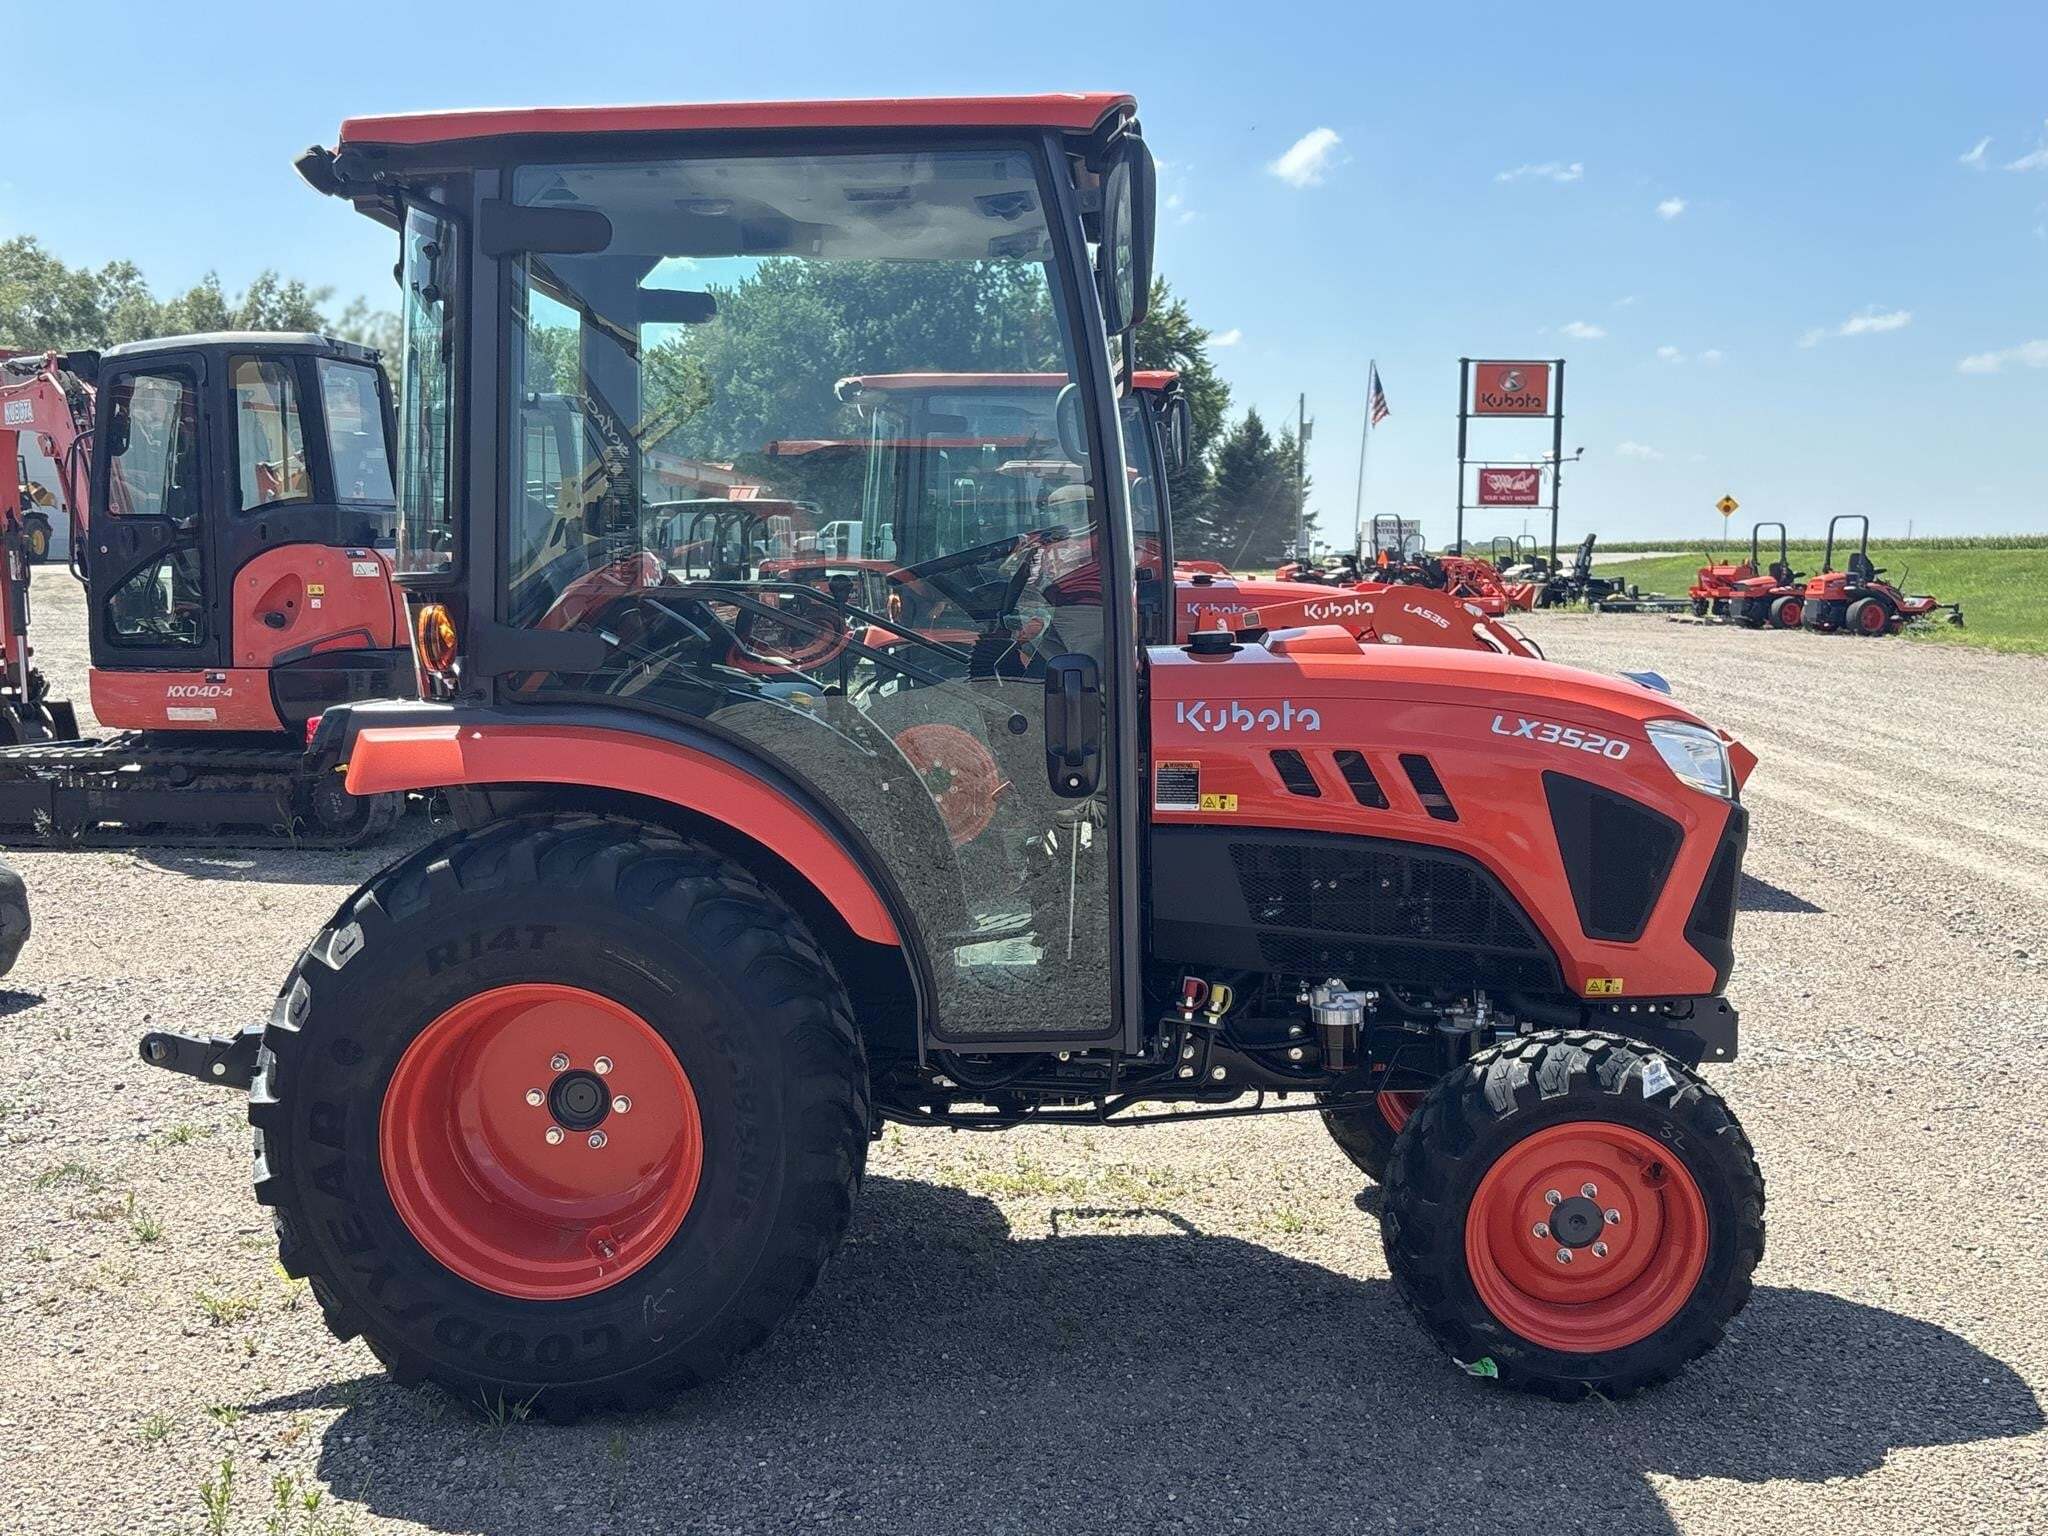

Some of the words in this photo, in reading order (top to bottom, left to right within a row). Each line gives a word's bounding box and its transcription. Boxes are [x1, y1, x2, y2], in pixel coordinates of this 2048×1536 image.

[1481, 392, 1541, 407] Kubota
[1304, 600, 1374, 620] Kubota
[1403, 603, 1450, 629] LA535
[167, 685, 233, 697] KX040-4
[1177, 701, 1320, 731] Kubota
[1491, 715, 1630, 760] LX3520
